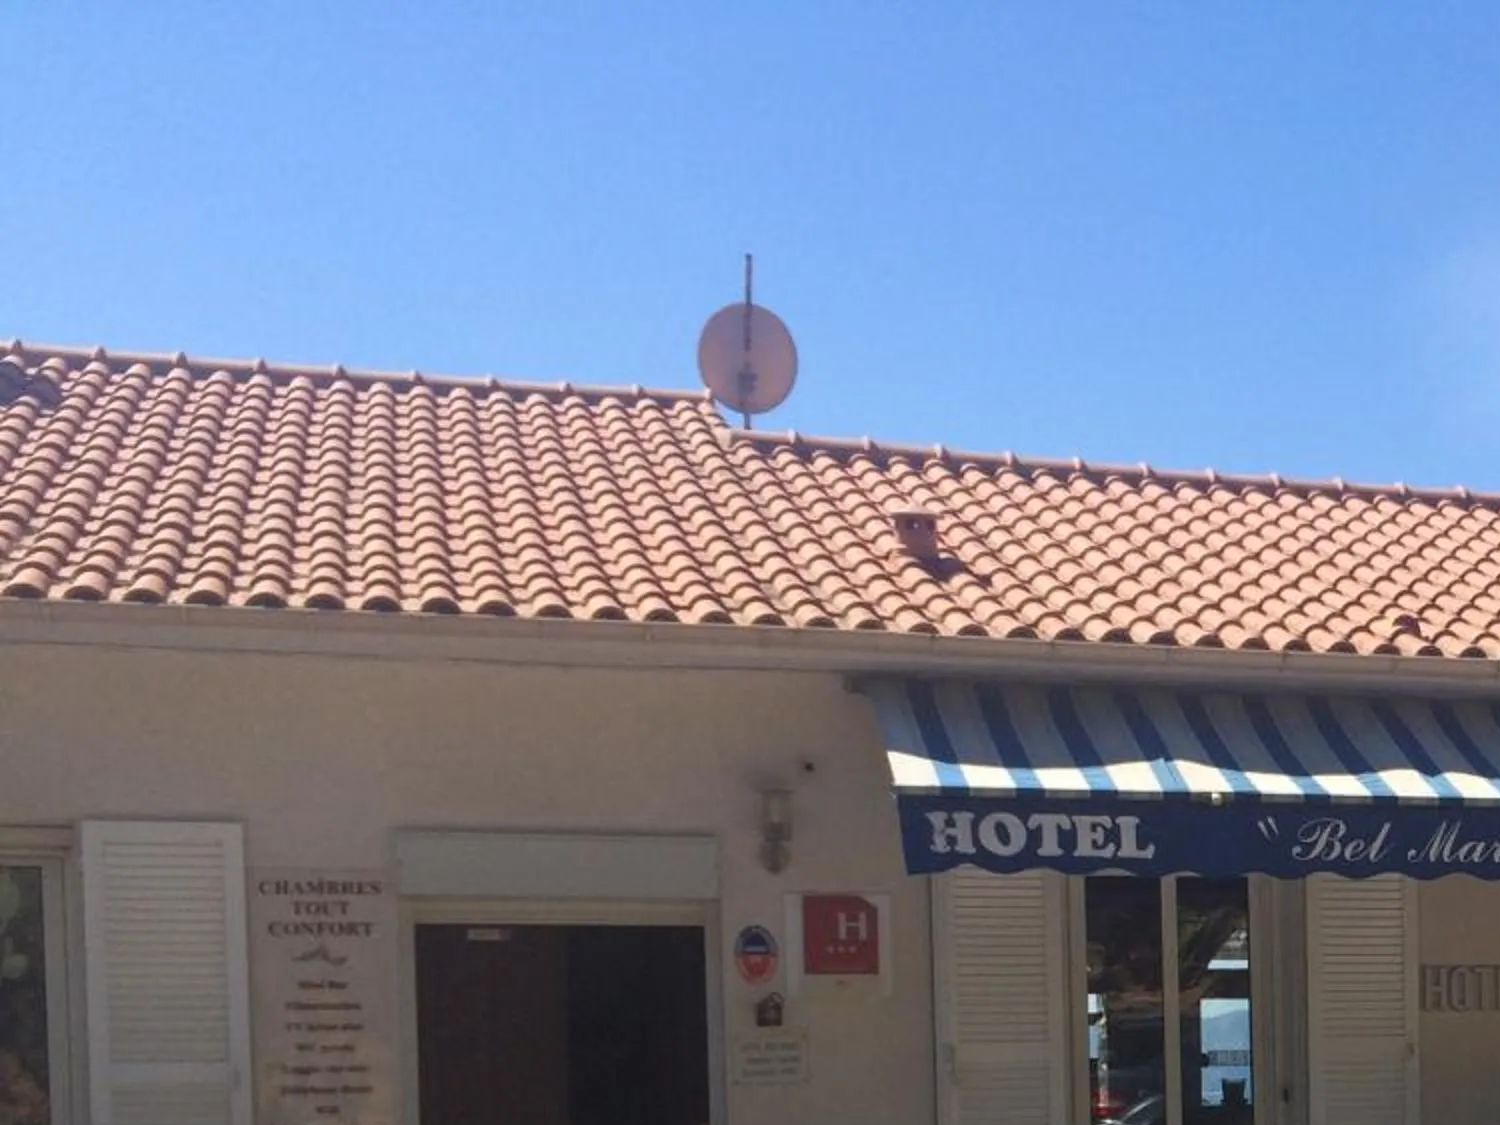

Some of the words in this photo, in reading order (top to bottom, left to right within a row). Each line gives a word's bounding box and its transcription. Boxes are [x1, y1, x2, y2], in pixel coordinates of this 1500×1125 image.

[926, 811, 1155, 859] HOTEL
[257, 879, 383, 896] CHAMBRES
[290, 900, 351, 916] TOUT
[267, 921, 375, 938] CONFORT
[838, 911, 867, 941] H
